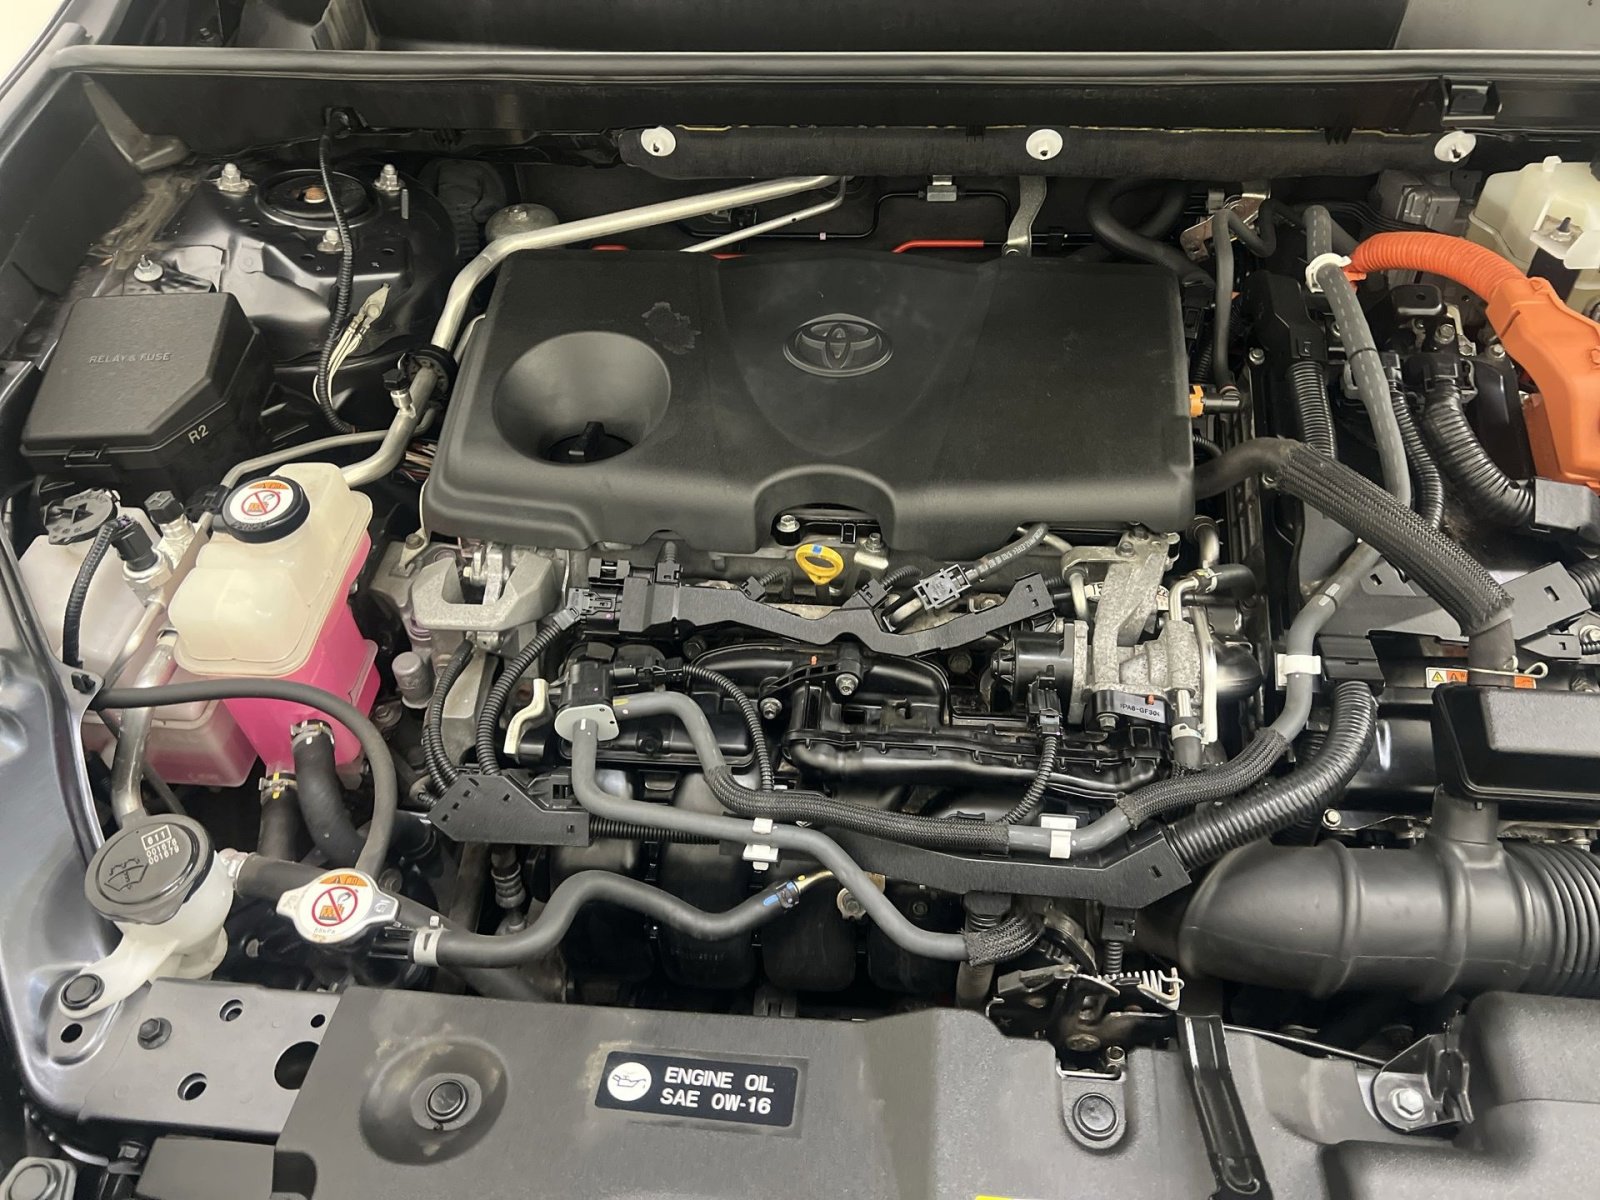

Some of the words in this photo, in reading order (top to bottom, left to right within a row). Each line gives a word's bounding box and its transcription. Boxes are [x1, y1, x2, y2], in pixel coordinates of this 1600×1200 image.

[89, 353, 127, 363] RELAY
[140, 351, 171, 361] FUSE
[188, 424, 209, 444] R2
[664, 1066, 734, 1089] ENGINE
[744, 1074, 775, 1093] OIL
[660, 1088, 701, 1108] SAE
[711, 1093, 772, 1115] 0W-16
